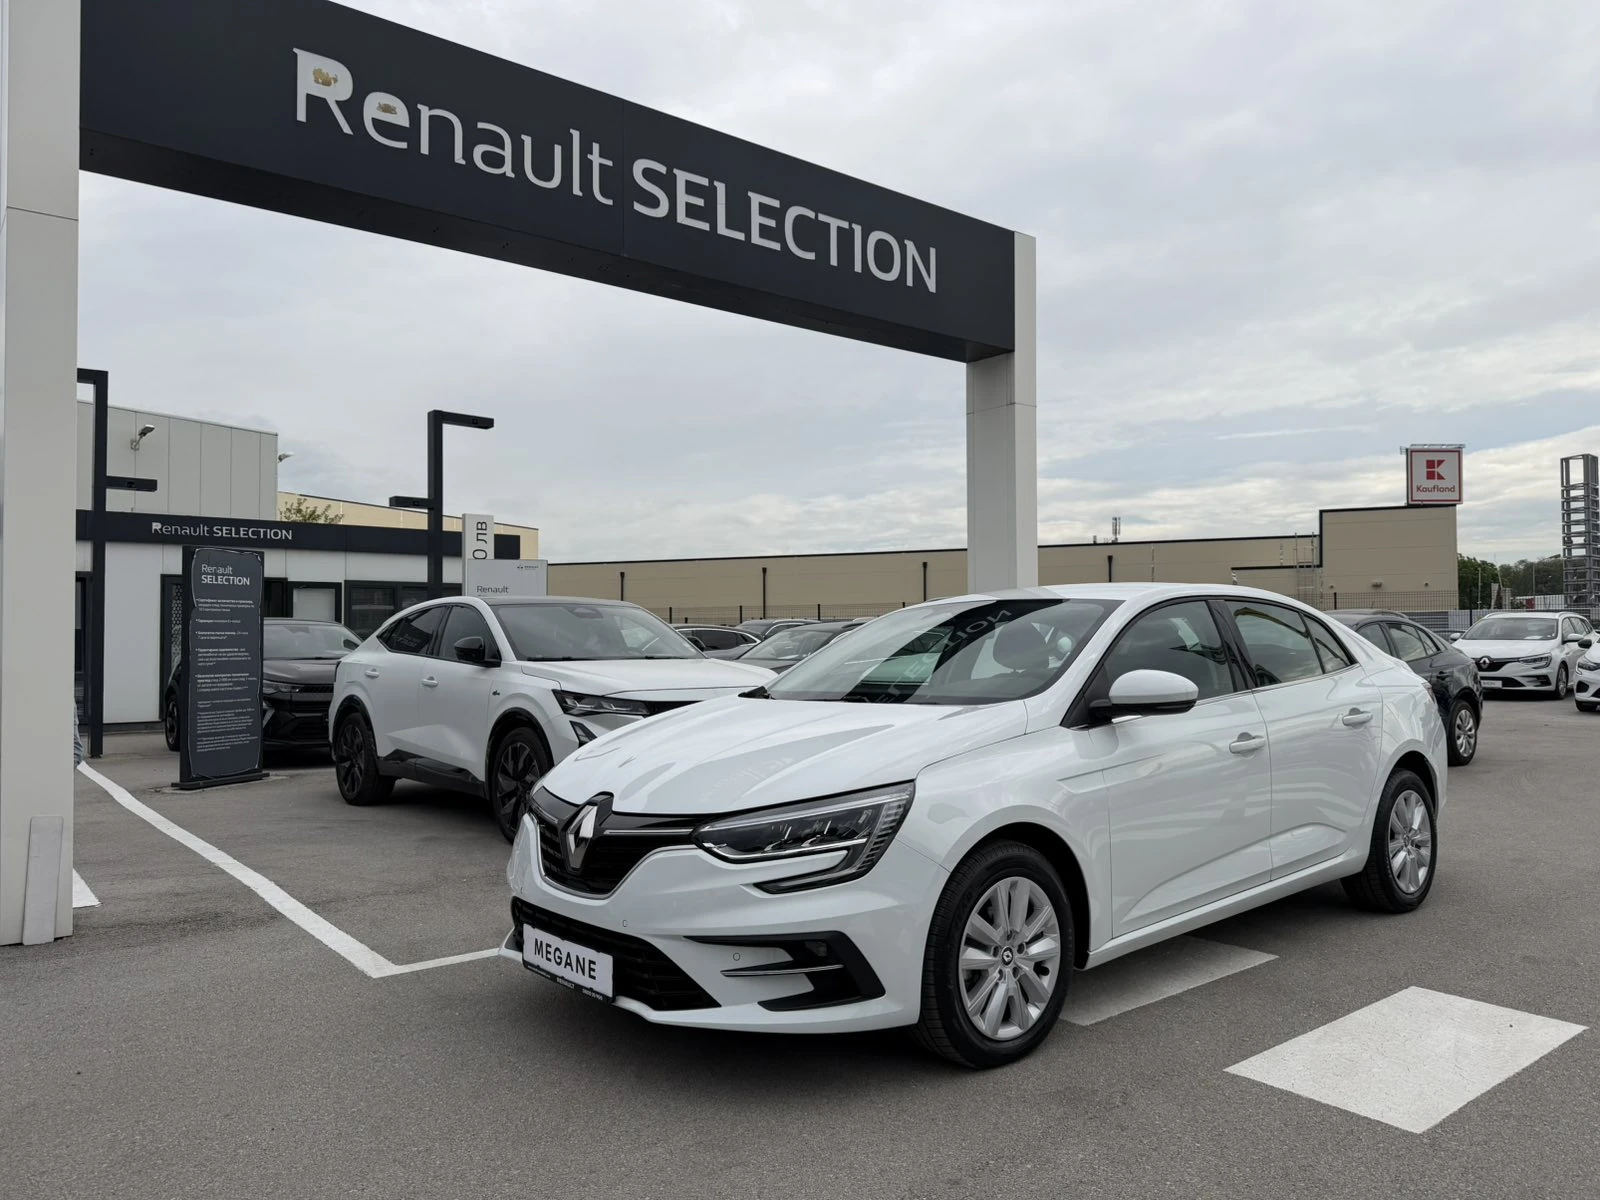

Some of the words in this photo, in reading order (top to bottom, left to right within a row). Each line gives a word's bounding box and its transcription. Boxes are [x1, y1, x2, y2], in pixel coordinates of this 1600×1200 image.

[293, 47, 614, 206] Renault
[632, 157, 937, 293] SELECTION
[1416, 484, 1456, 493] Kaufland
[151, 521, 209, 537] Renault
[212, 526, 293, 540] SELECTION
[201, 564, 233, 575] Renault
[201, 575, 250, 586] SELECTION
[476, 585, 509, 594] Renault
[534, 938, 596, 980] MEGANE
